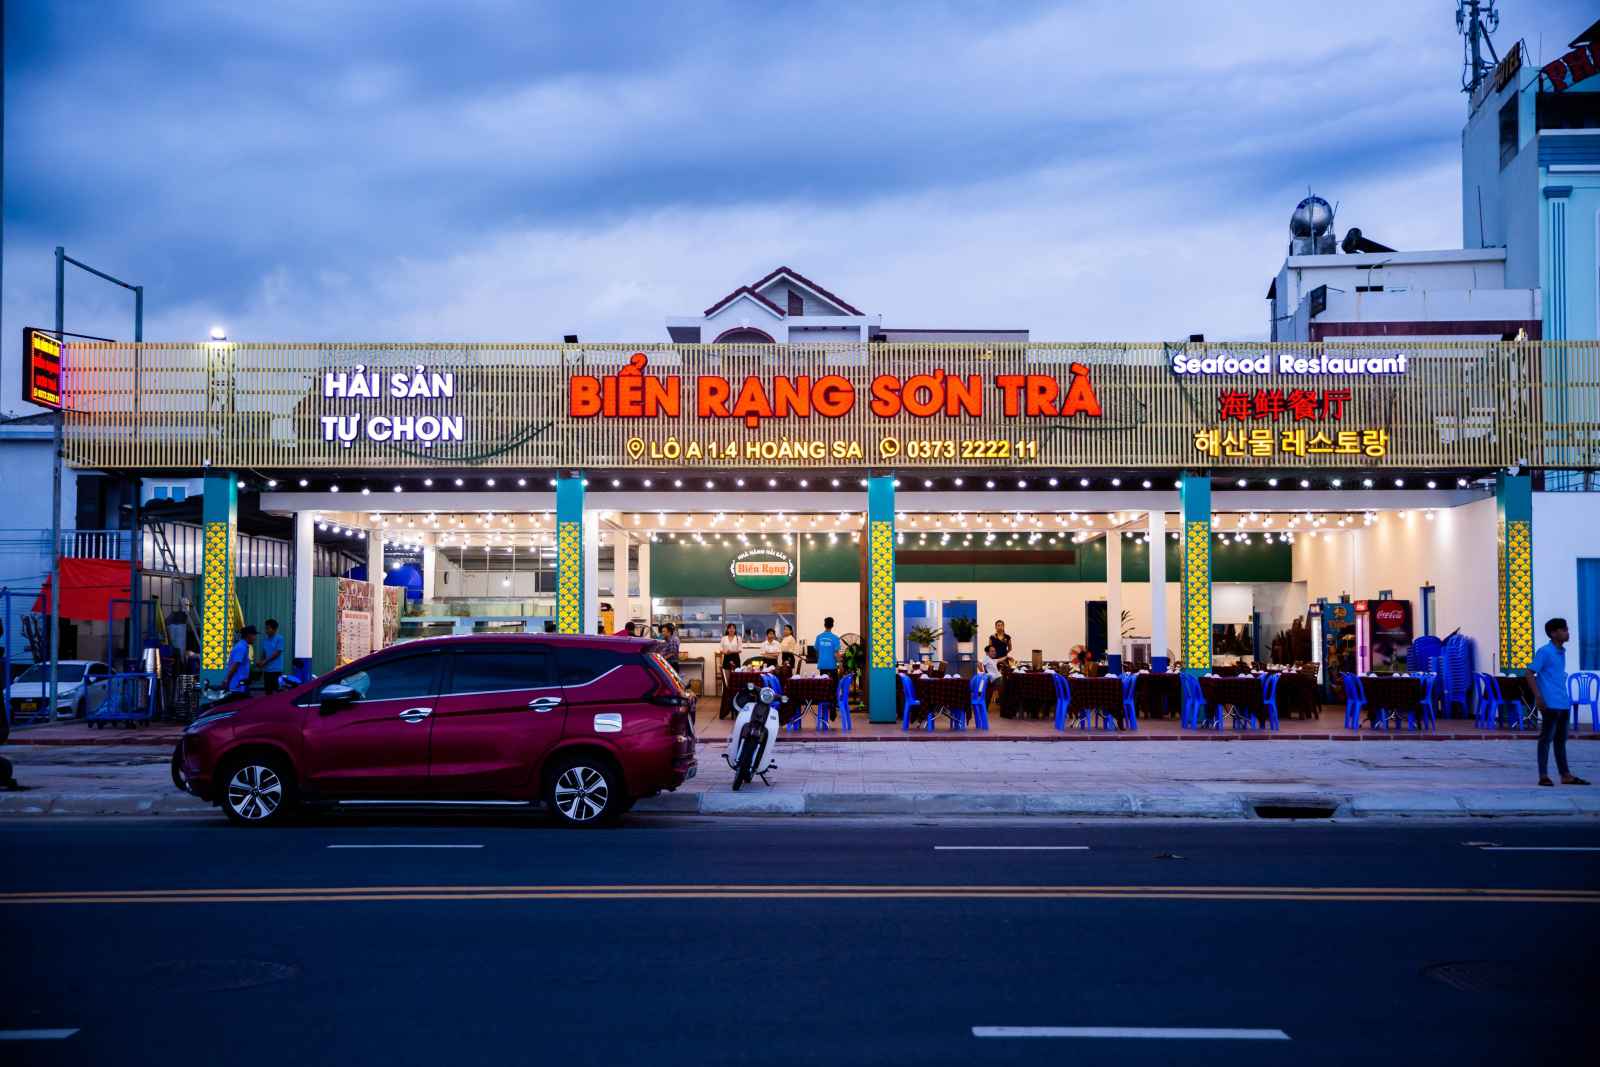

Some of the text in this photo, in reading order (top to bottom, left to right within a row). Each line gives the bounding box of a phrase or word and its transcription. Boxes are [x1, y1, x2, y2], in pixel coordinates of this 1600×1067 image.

[1173, 354, 1407, 374] Seafood Restaurant
[324, 364, 454, 399] HẢI SẢN
[570, 352, 1102, 428] BIỂN RẠNG SƠN TRÀ
[1218, 387, 1352, 421] 海鲜餐厅
[321, 413, 464, 448] TỰ CHỌN
[1194, 427, 1390, 457] 해산물 레스토랑
[651, 437, 864, 459] LÔ A 1.4 HOÀNG SA
[907, 441, 1037, 458] 0373 2222 11
[1376, 609, 1404, 619] Coca-Cola
